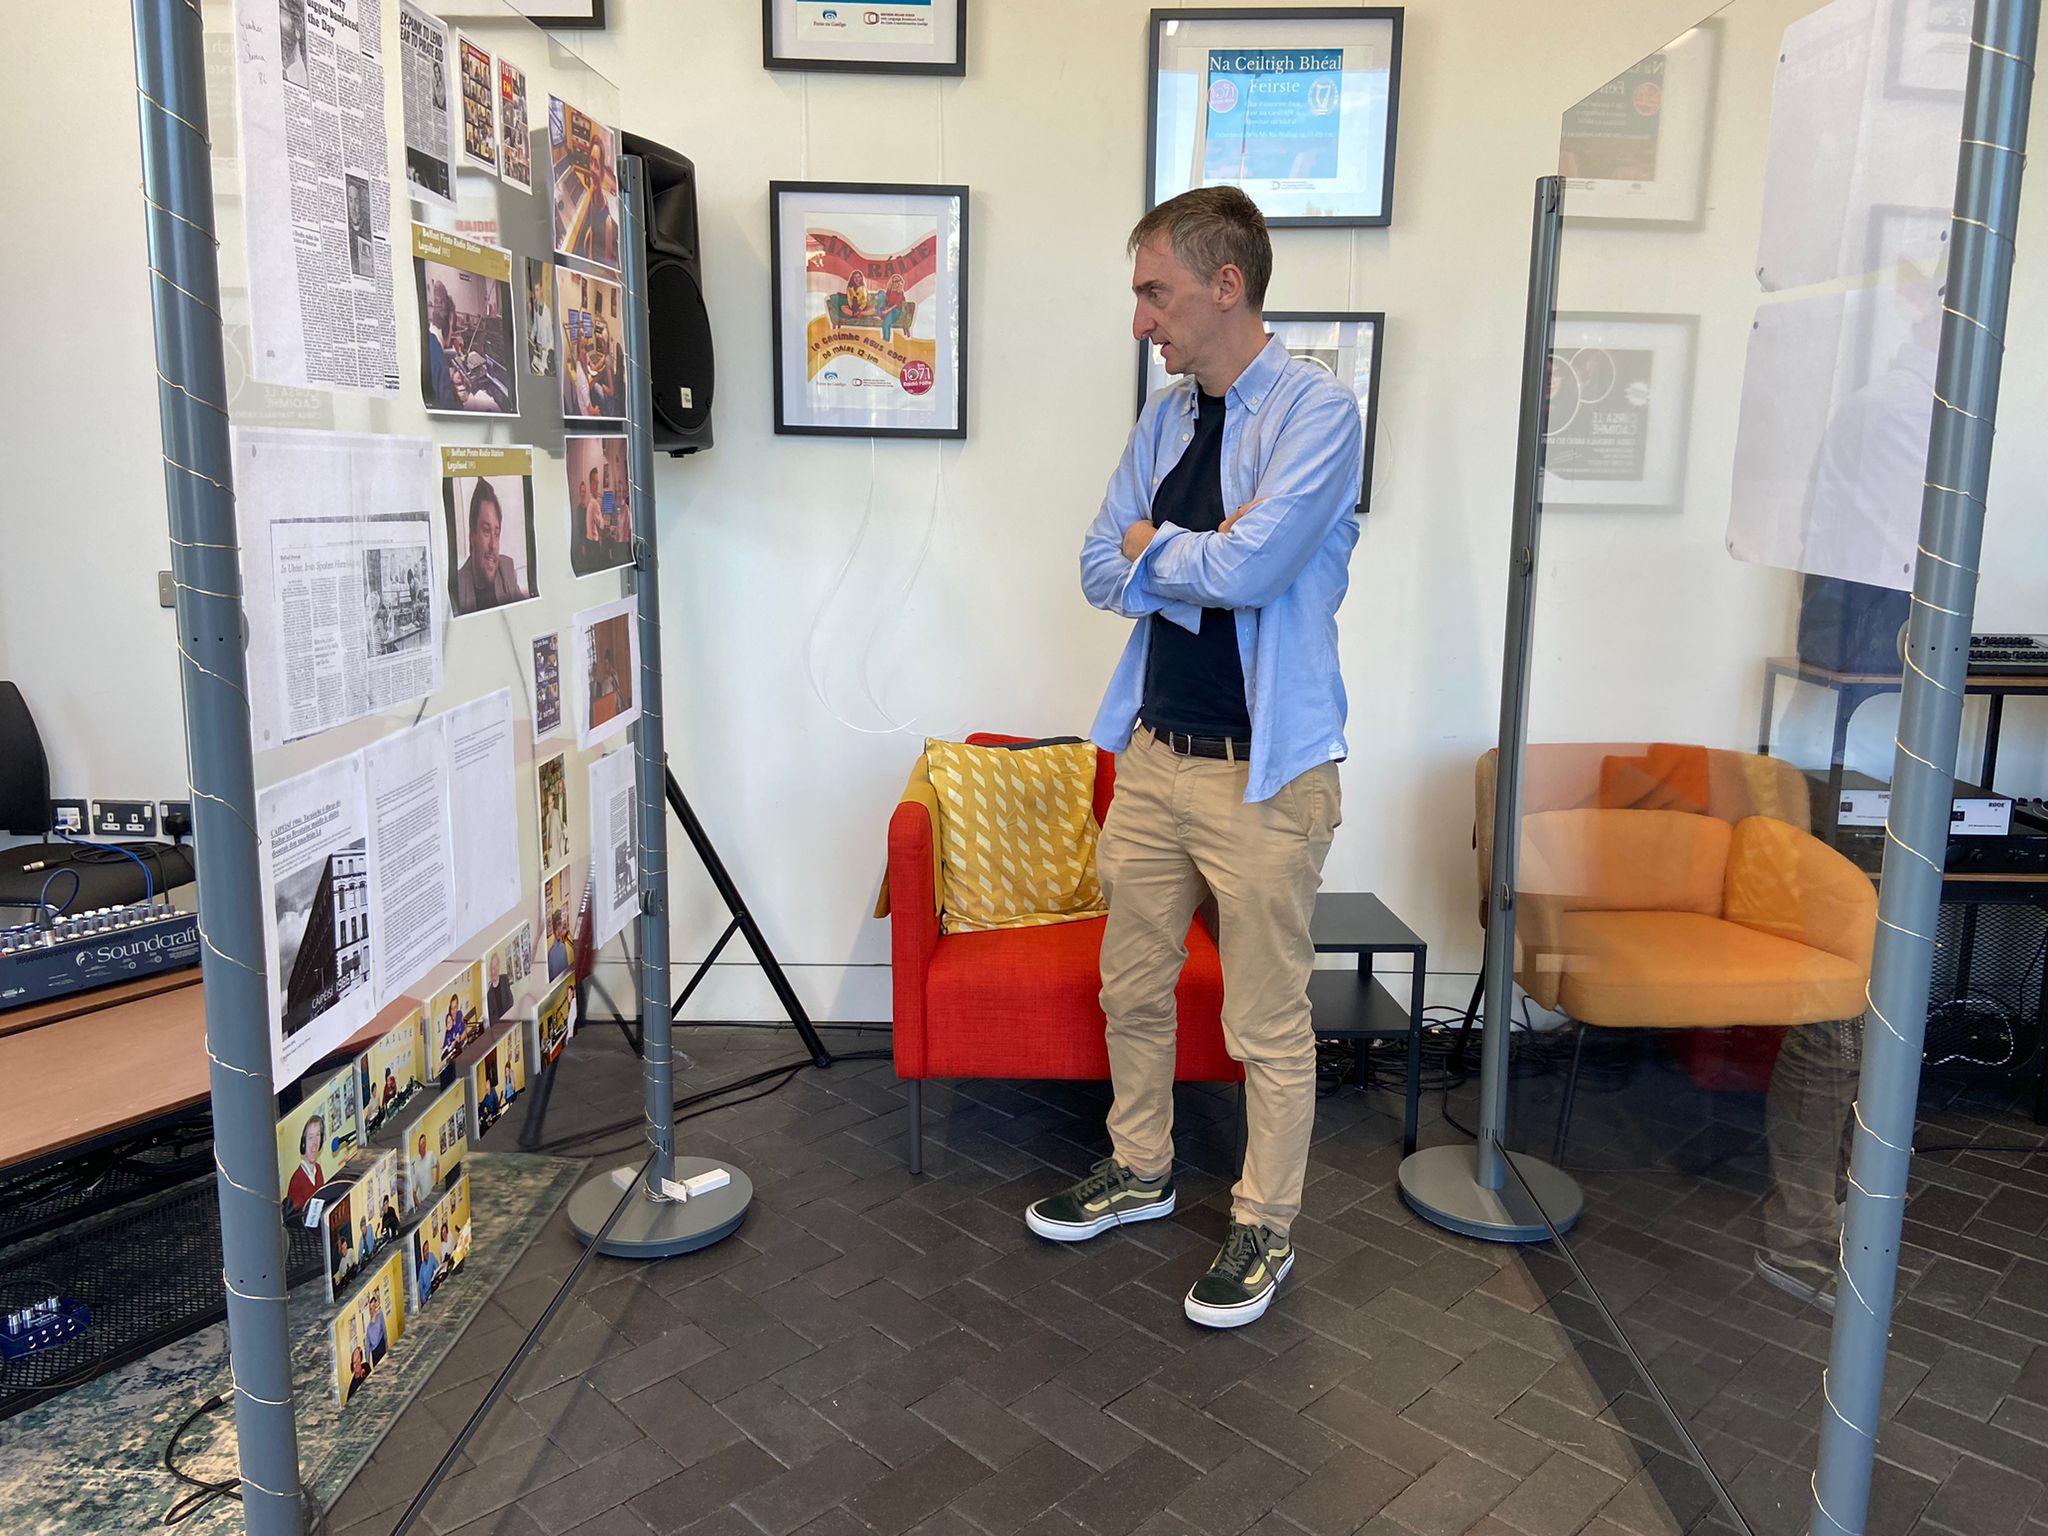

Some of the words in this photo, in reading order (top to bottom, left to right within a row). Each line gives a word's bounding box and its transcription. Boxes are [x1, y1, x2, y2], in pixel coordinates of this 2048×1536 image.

[308, 13, 320, 27] the
[321, 19, 336, 37] Day
[423, 25, 430, 40] TO
[430, 30, 443, 48] LEND
[400, 27, 411, 43] EAR
[411, 32, 418, 48] TO
[418, 37, 434, 57] PIRATE
[434, 46, 444, 63] BID
[1209, 57, 1230, 71] Na
[1235, 55, 1294, 74] Ceiltigh
[1299, 55, 1342, 70] Bhéal
[503, 80, 512, 95] FM
[1249, 79, 1300, 93] Feirste
[97, 926, 197, 963] Soundcraft
